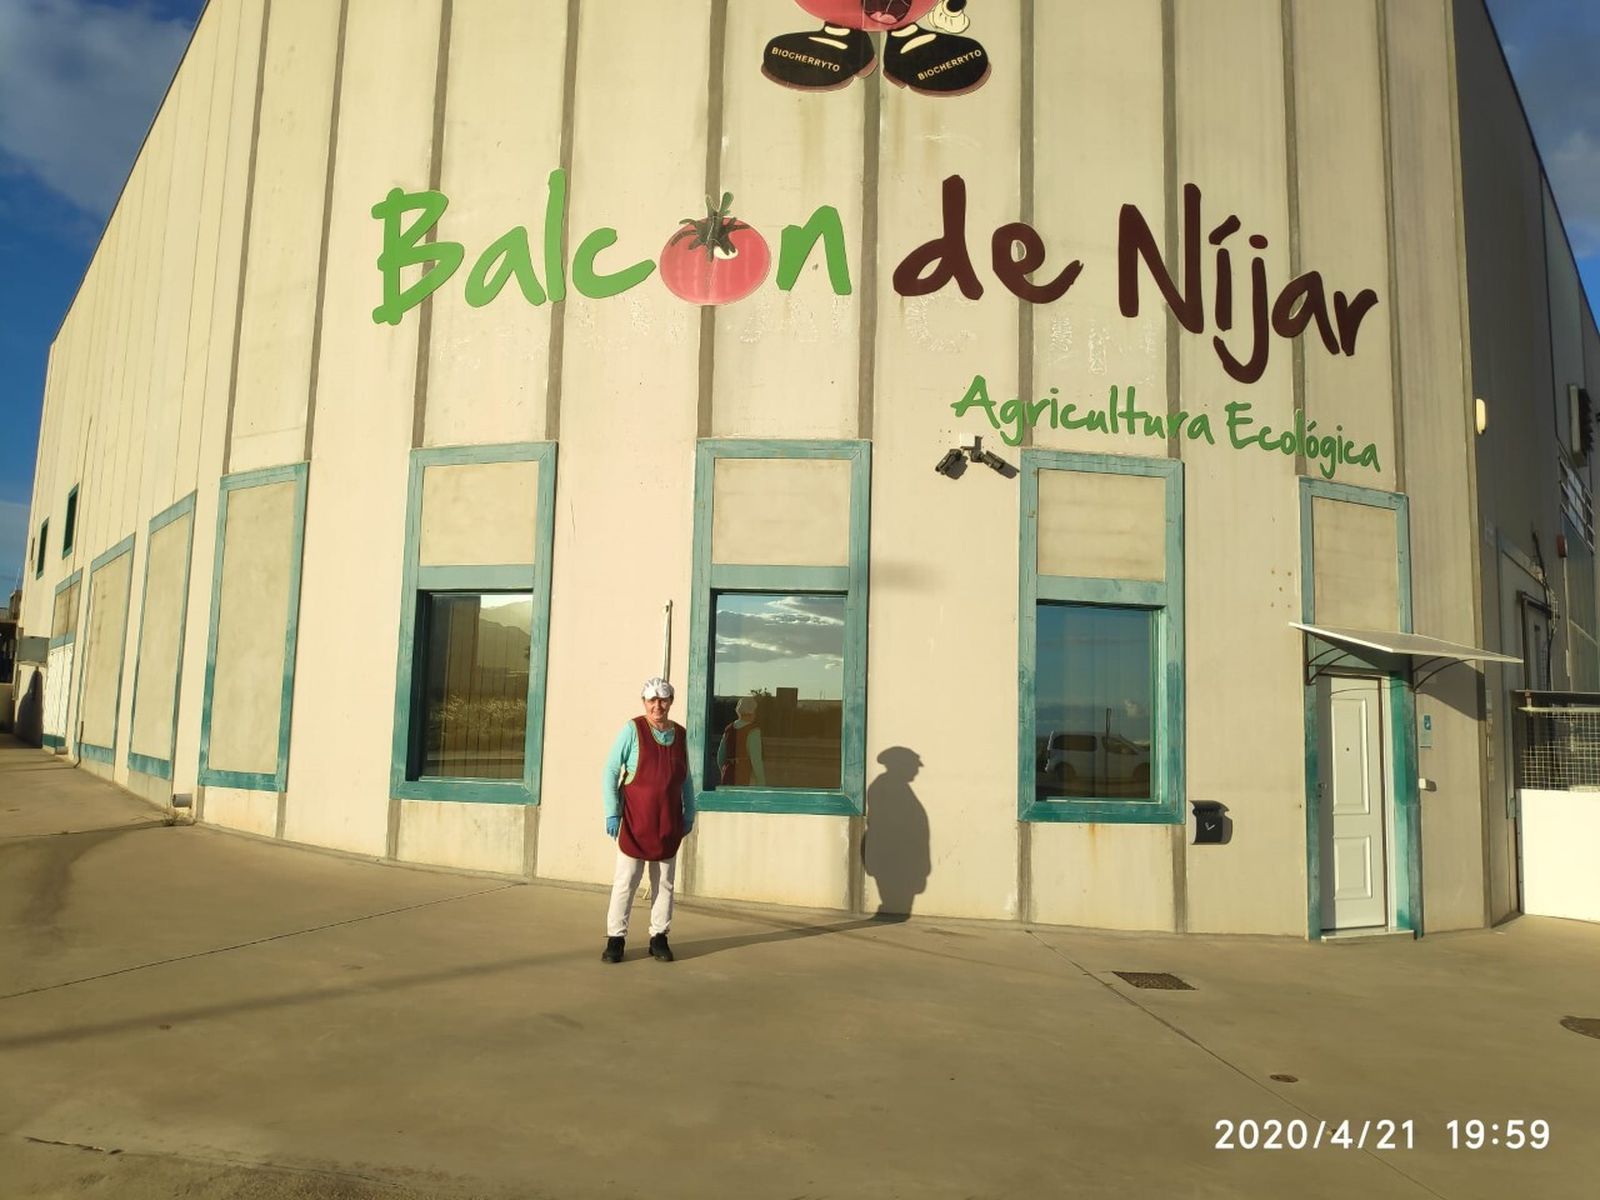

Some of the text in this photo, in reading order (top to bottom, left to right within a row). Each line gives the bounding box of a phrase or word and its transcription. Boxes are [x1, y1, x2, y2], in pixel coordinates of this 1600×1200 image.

[771, 47, 840, 73] BIOCHERRYTO
[918, 50, 982, 81] BIOCHERRYTO
[893, 174, 1083, 304] de
[1118, 183, 1379, 384] Níjar
[951, 375, 1380, 479] Agricultura Ecológica
